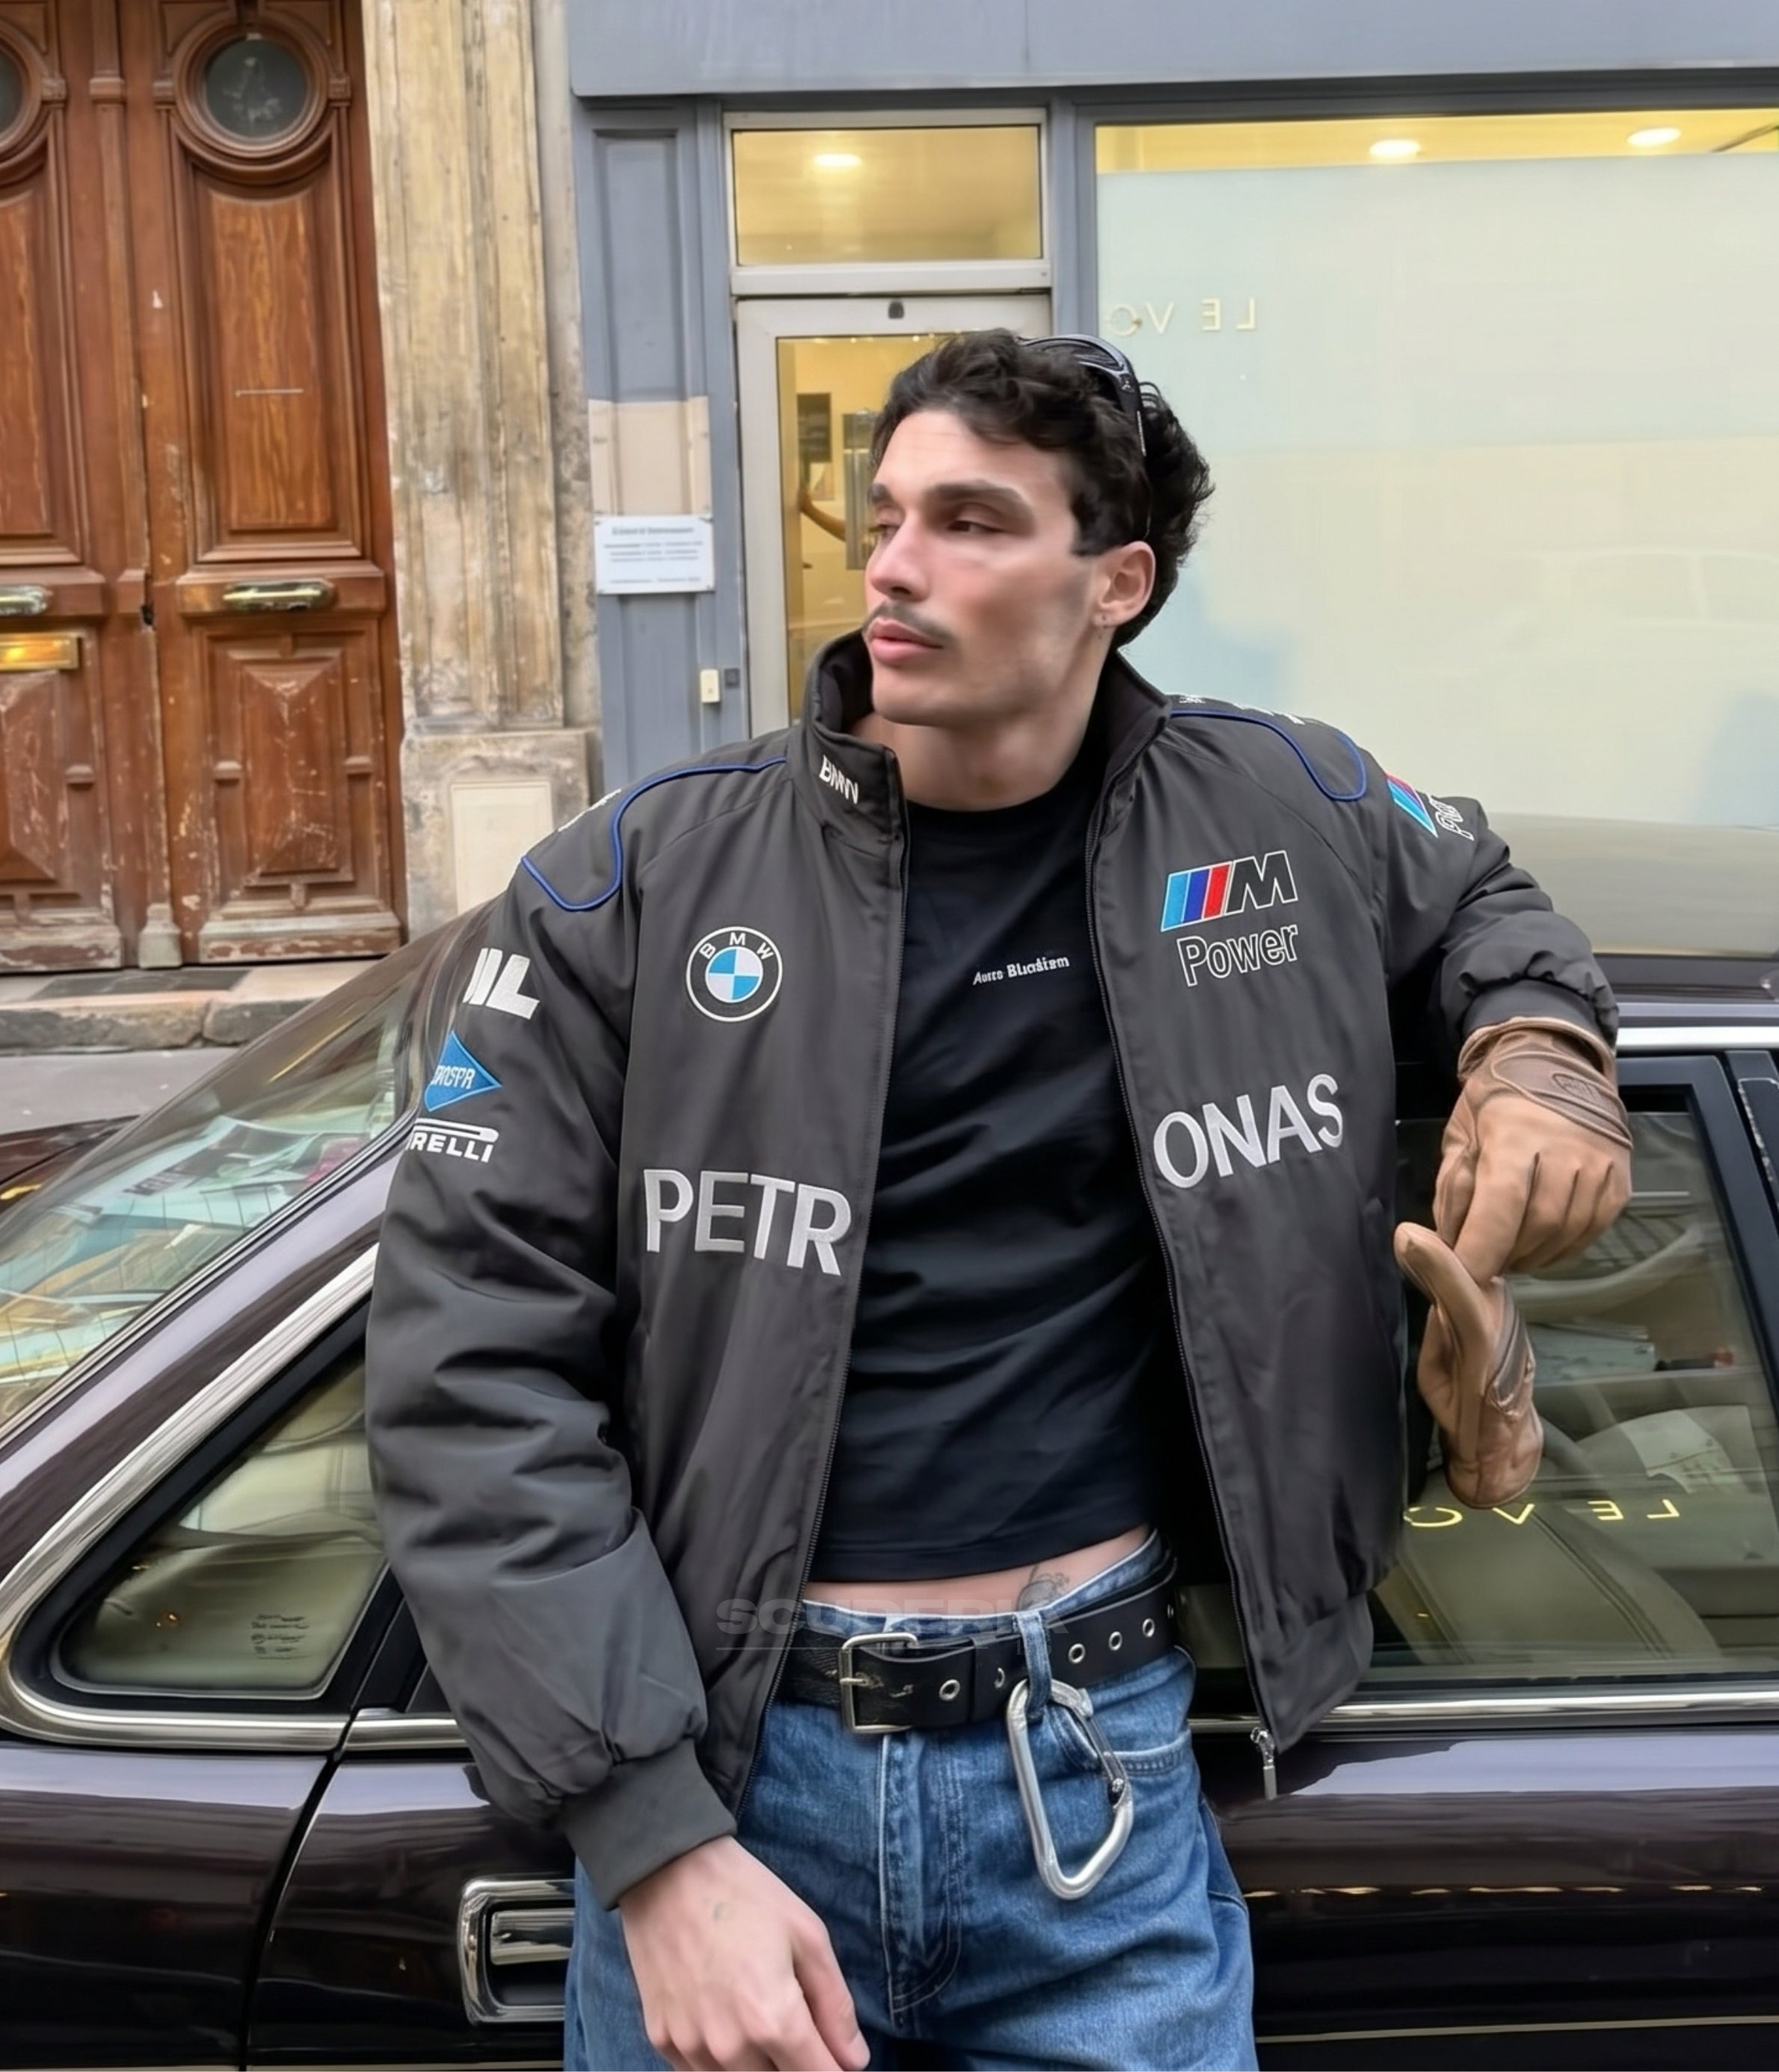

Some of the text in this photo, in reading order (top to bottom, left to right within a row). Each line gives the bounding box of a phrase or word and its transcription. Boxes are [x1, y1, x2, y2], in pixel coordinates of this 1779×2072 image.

[818, 754, 859, 805] BMW
[698, 932, 775, 960] BMW
[1176, 924, 1299, 987] Power
[643, 1074, 1344, 1276] PETR ONAS
